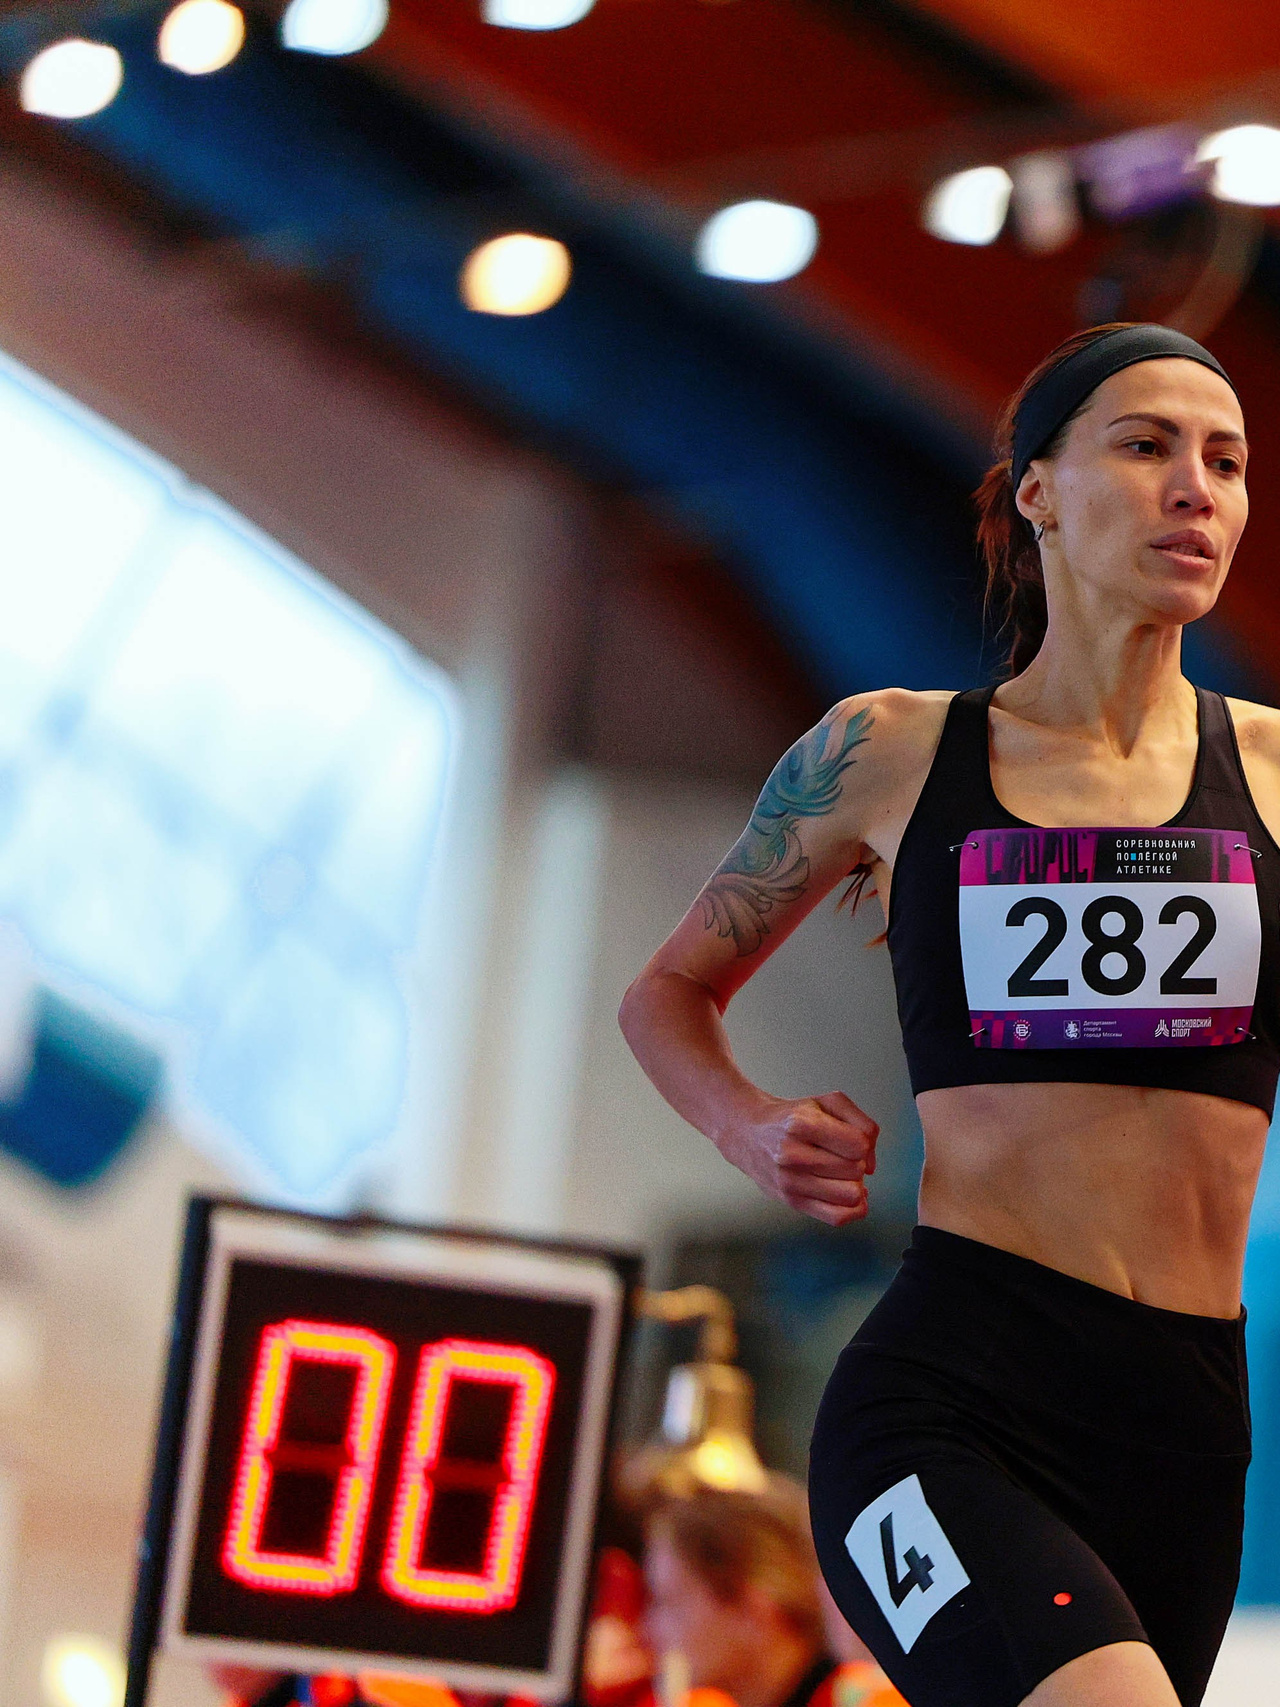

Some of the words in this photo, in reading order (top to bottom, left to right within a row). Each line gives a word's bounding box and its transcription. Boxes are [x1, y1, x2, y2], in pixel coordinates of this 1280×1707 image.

[1116, 839, 1196, 849] СОРЕВНОВАНИЯ
[1116, 865, 1171, 874] АТЛЕТИКЕ
[1005, 895, 1217, 998] 282
[1171, 1016, 1212, 1028] МОСКОВСКИЙ
[1171, 1028, 1191, 1037] СПОРТ
[222, 1318, 556, 1614] 00
[879, 1511, 935, 1610] 4
